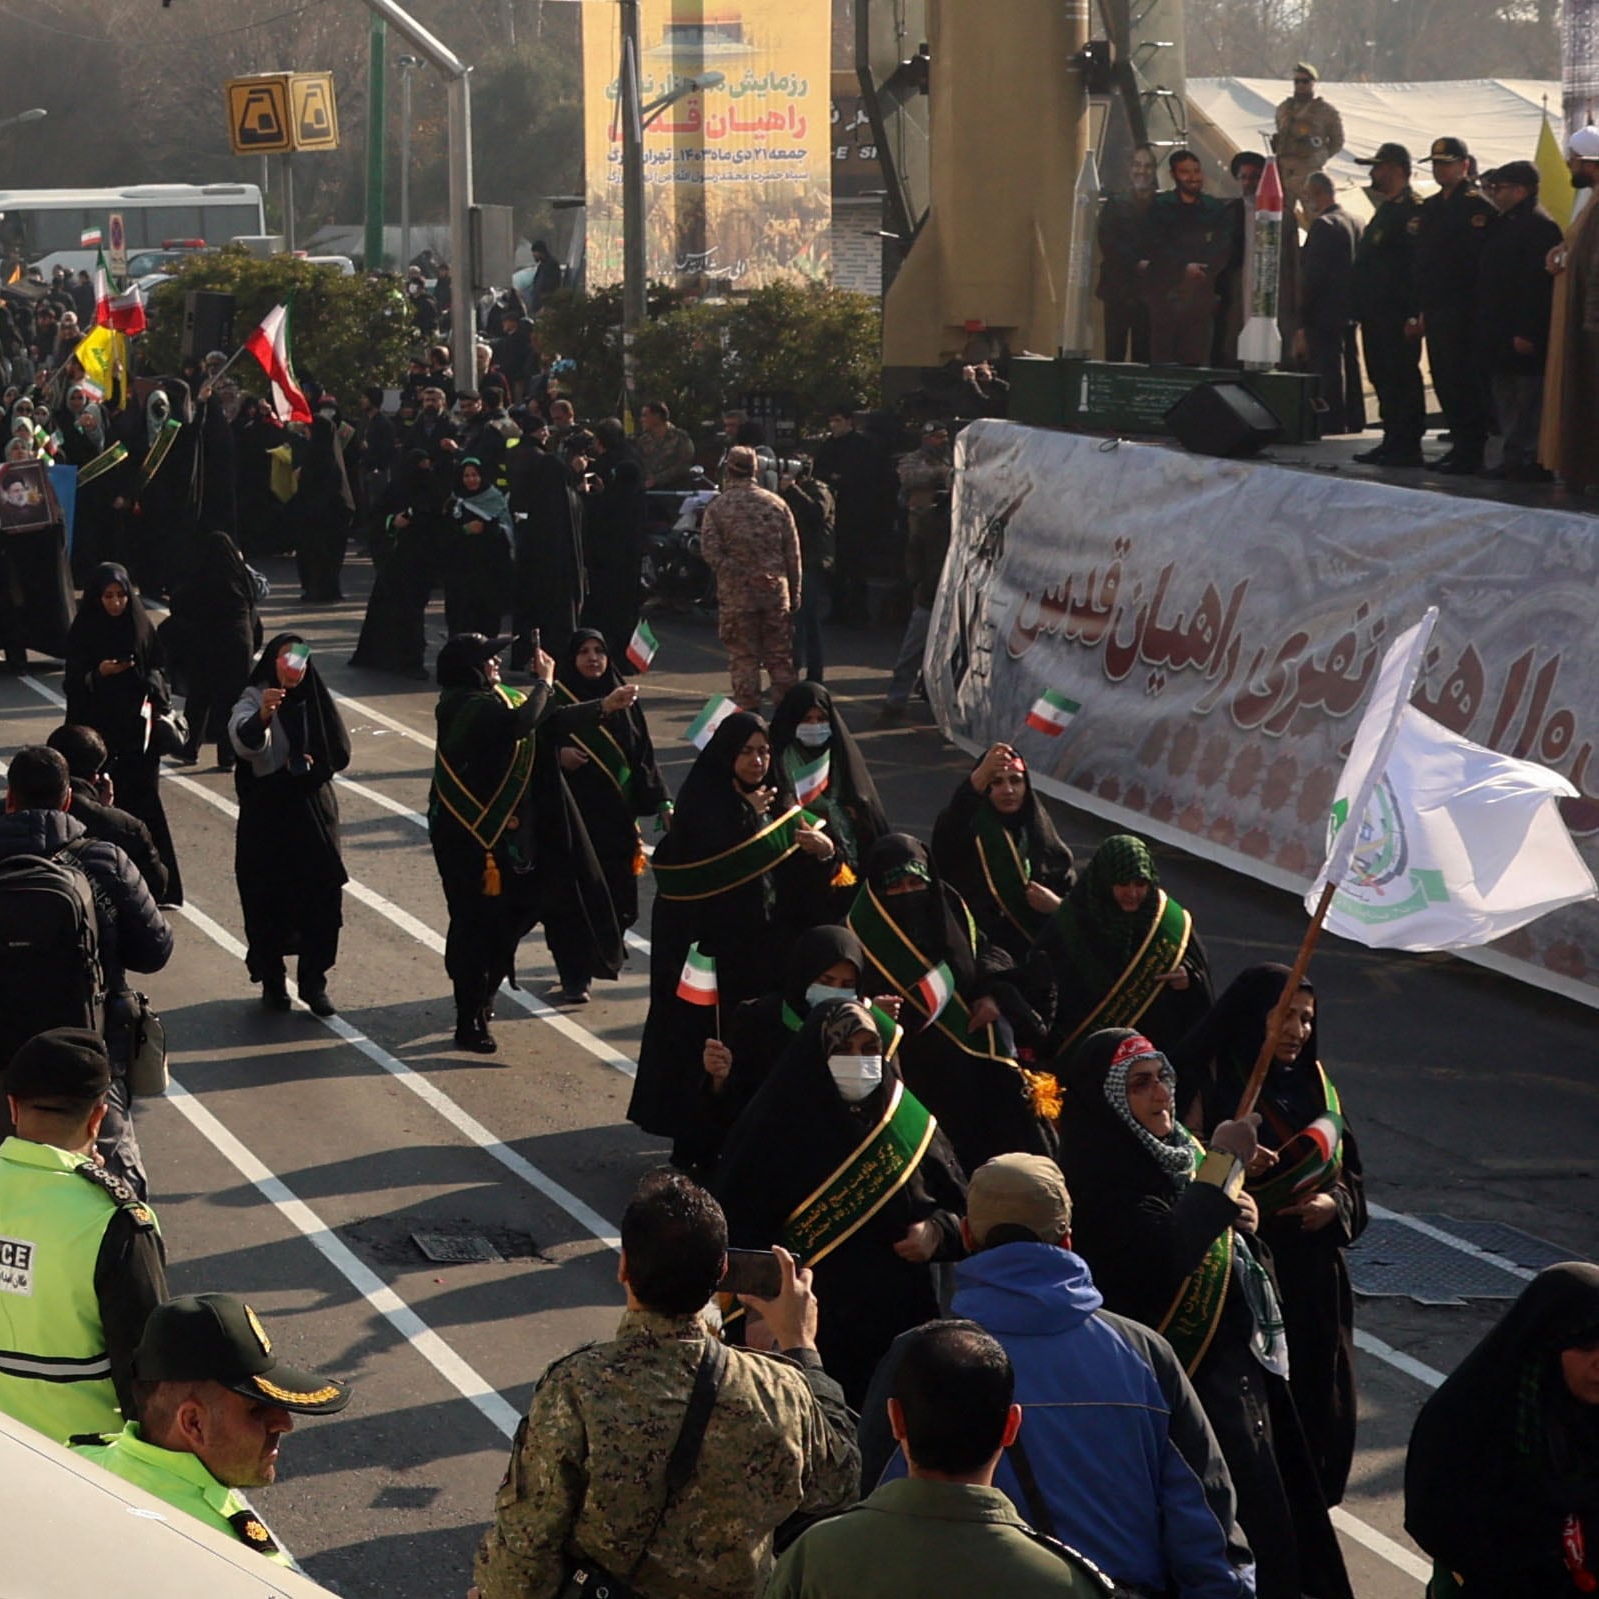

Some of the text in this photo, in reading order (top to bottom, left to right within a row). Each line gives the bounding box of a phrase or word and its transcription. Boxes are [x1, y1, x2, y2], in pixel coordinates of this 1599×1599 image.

[706, 103, 808, 141] راهیان
[728, 69, 808, 99] رزمایش
[769, 148, 808, 164] جمعه
[1007, 535, 1132, 659] قدس
[1105, 561, 1250, 713] راهیان
[1232, 599, 1387, 737] نفری
